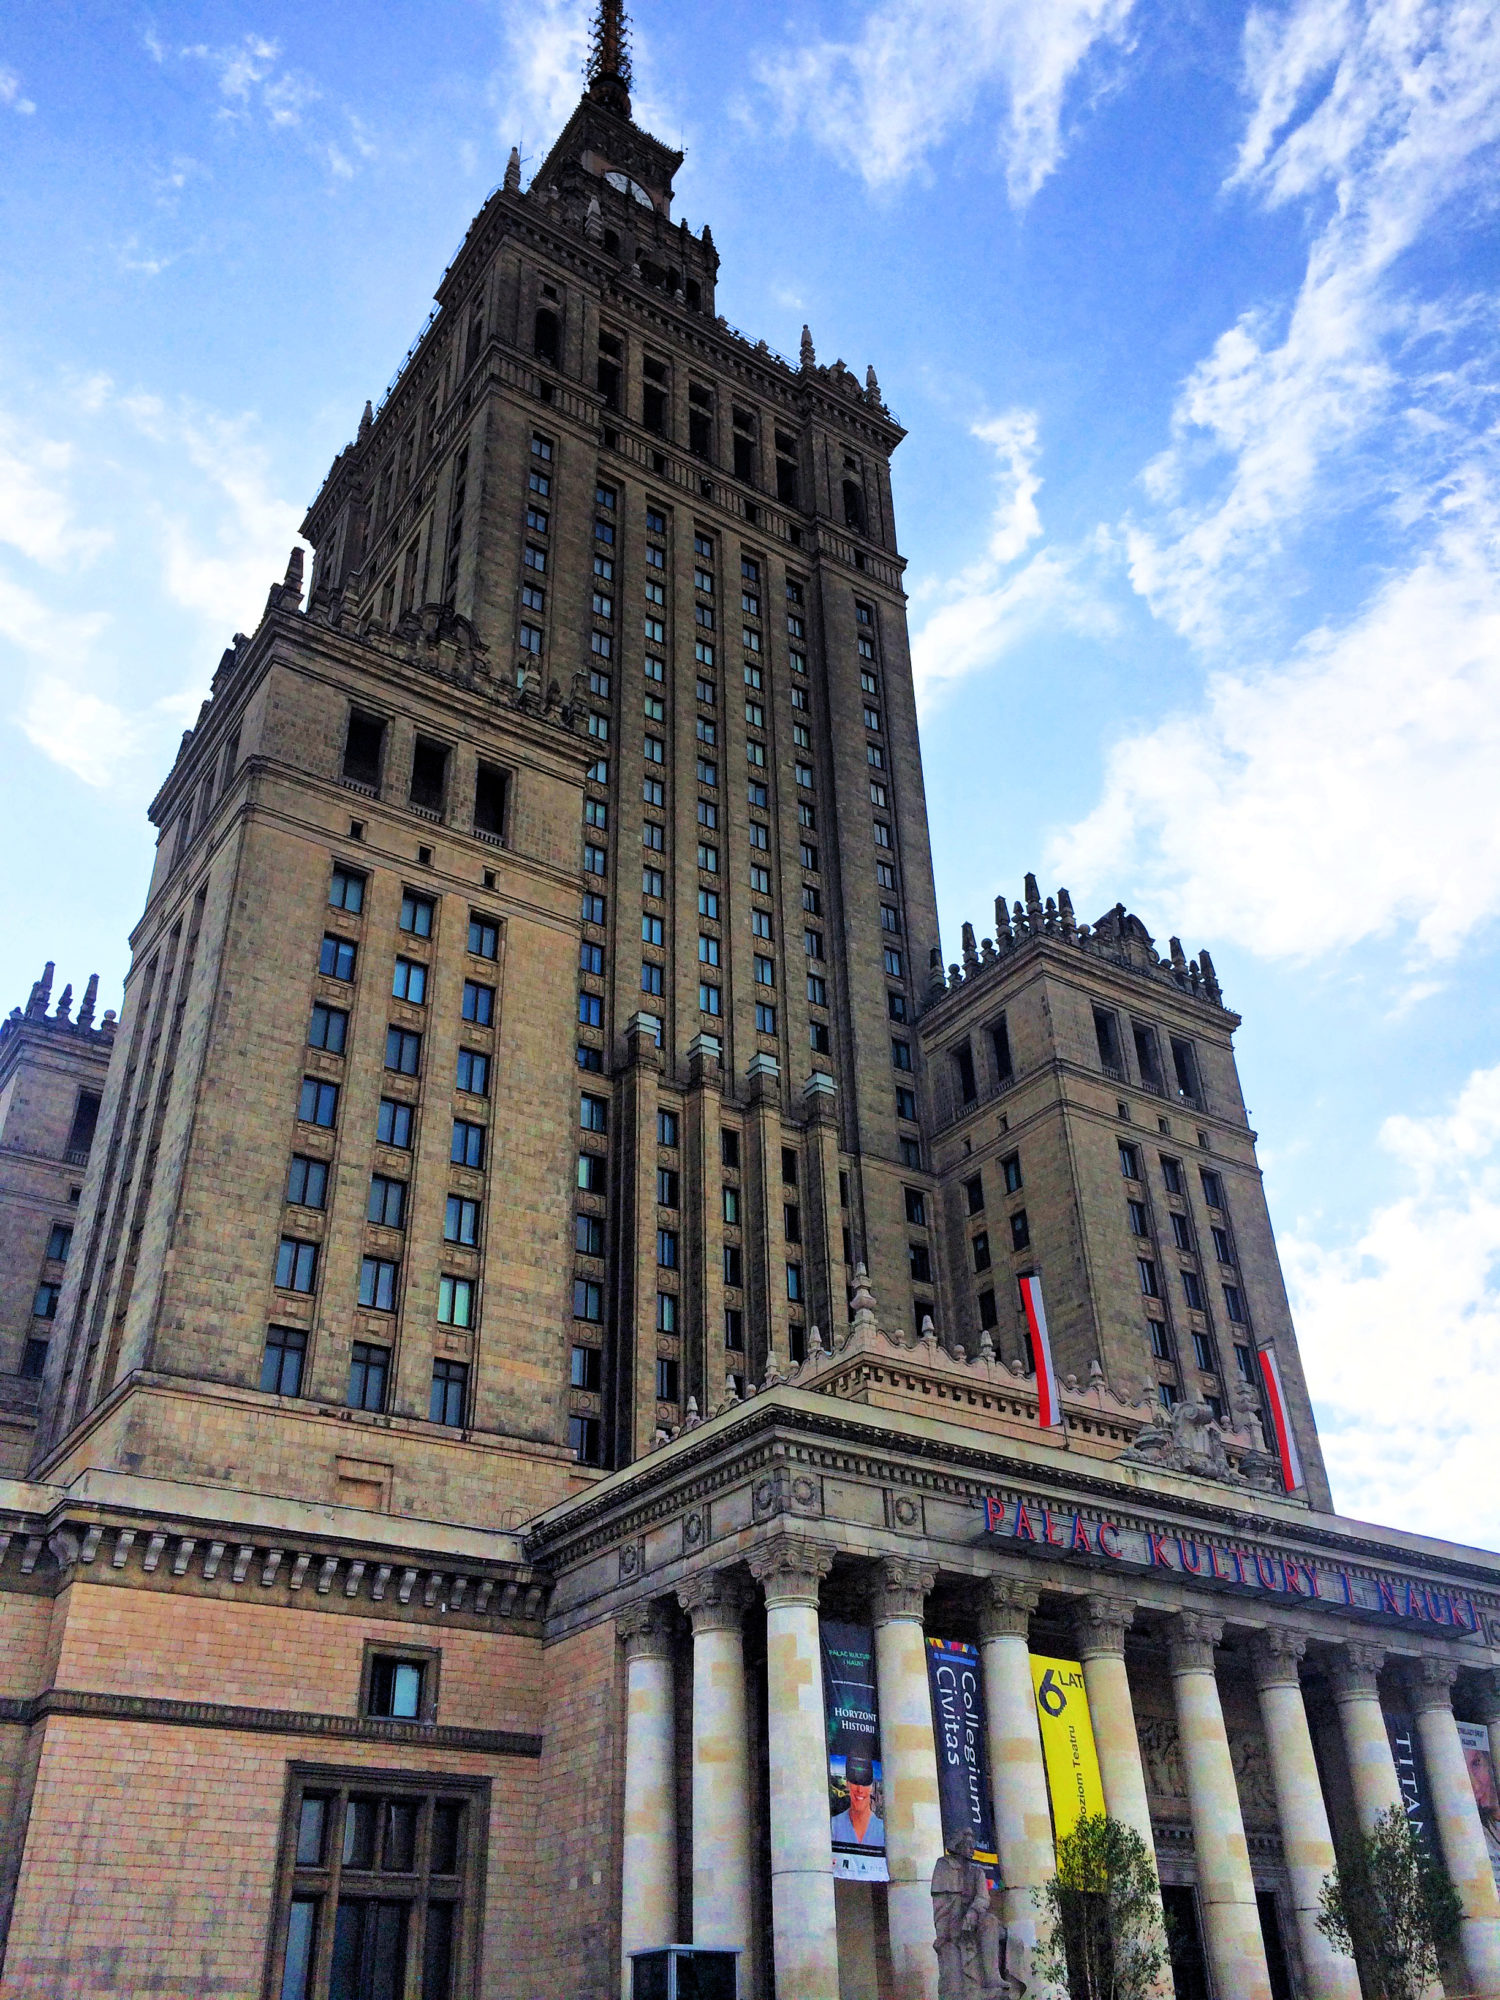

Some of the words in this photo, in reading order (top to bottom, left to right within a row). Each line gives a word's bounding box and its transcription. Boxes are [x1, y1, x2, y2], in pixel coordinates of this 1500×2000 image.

[983, 1497, 1122, 1558] PAŁAC
[1149, 1533, 1321, 1598] KULTURY
[1341, 1572, 1354, 1605] I
[1376, 1581, 1481, 1630] NAUKI
[936, 1666, 960, 1765] Civitas
[1038, 1669, 1067, 1718] 6
[1058, 1671, 1083, 1688] LAT
[962, 1672, 982, 1824] Collegium
[1068, 1725, 1081, 1768] Teatru
